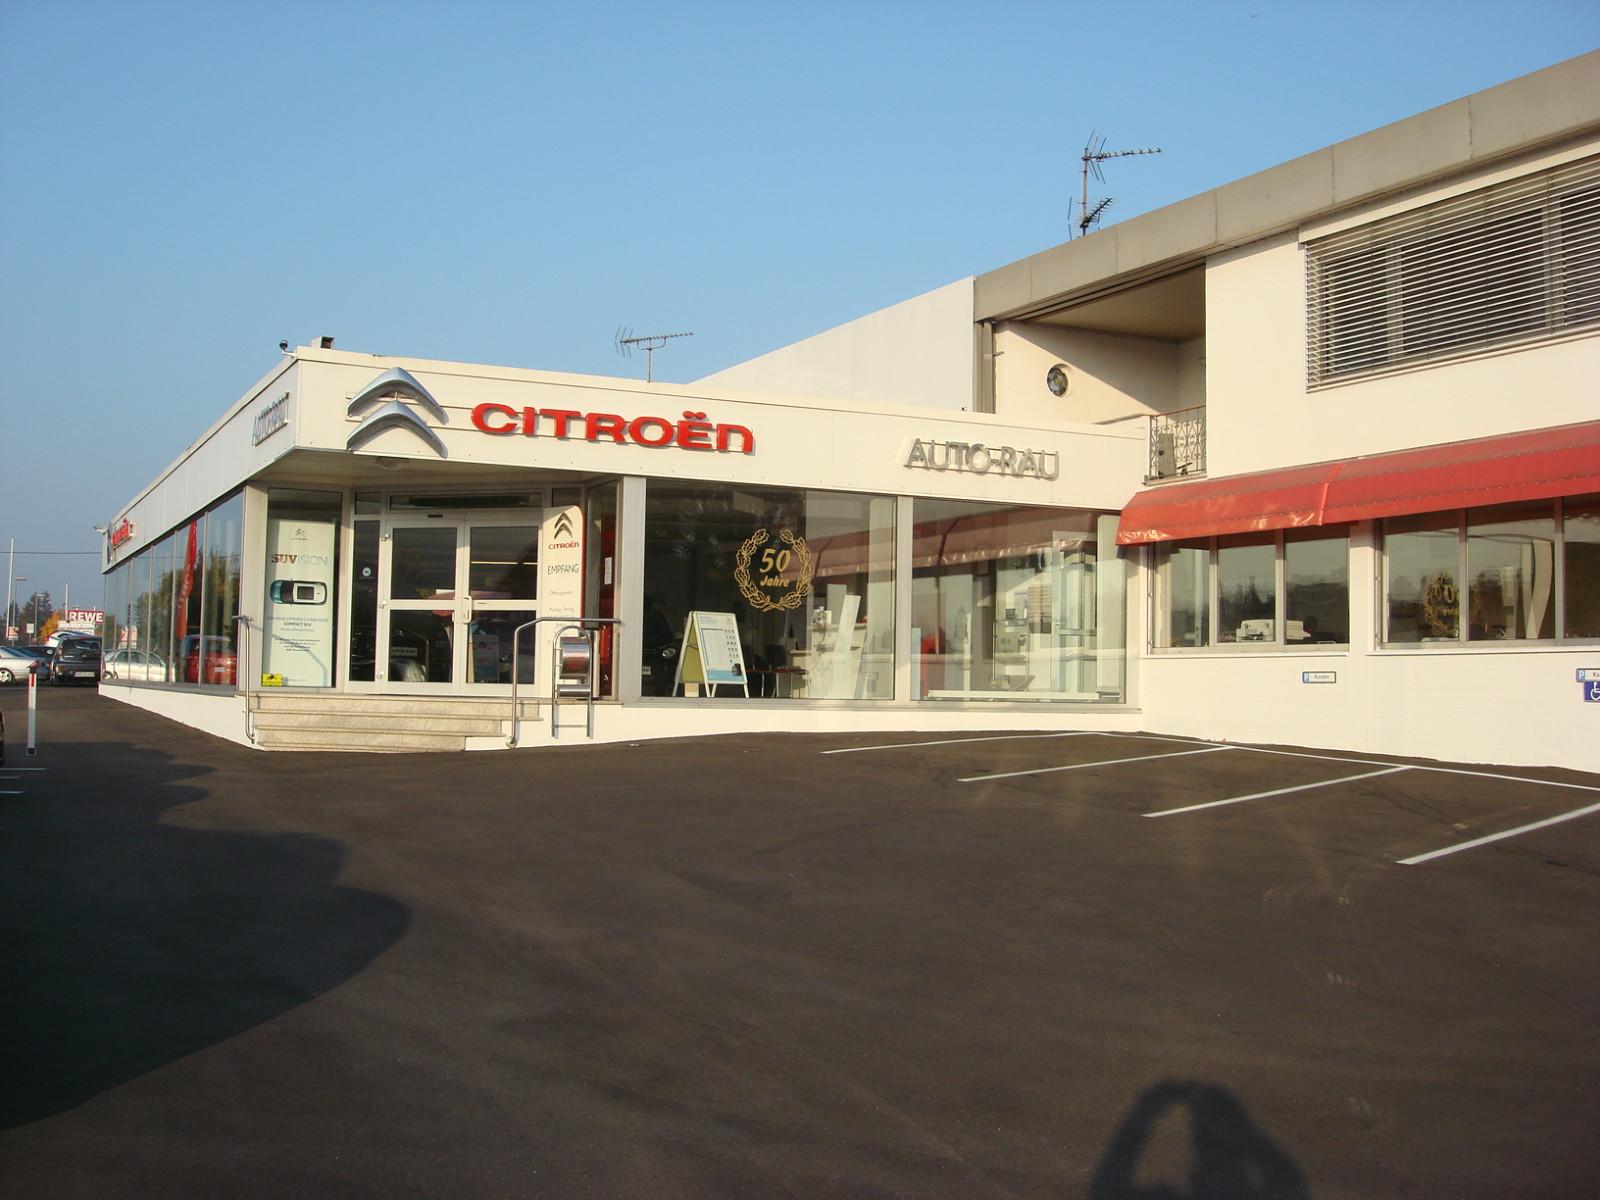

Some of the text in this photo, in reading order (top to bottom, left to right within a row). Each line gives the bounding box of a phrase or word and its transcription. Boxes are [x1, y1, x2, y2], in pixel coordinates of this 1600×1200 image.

[471, 400, 754, 455] CITROËN
[903, 438, 1060, 481] AUTO-RAU
[547, 563, 579, 575] EMPFANG
[760, 548, 791, 573] 50
[760, 575, 790, 587] Jahre
[69, 611, 103, 622] REWE
